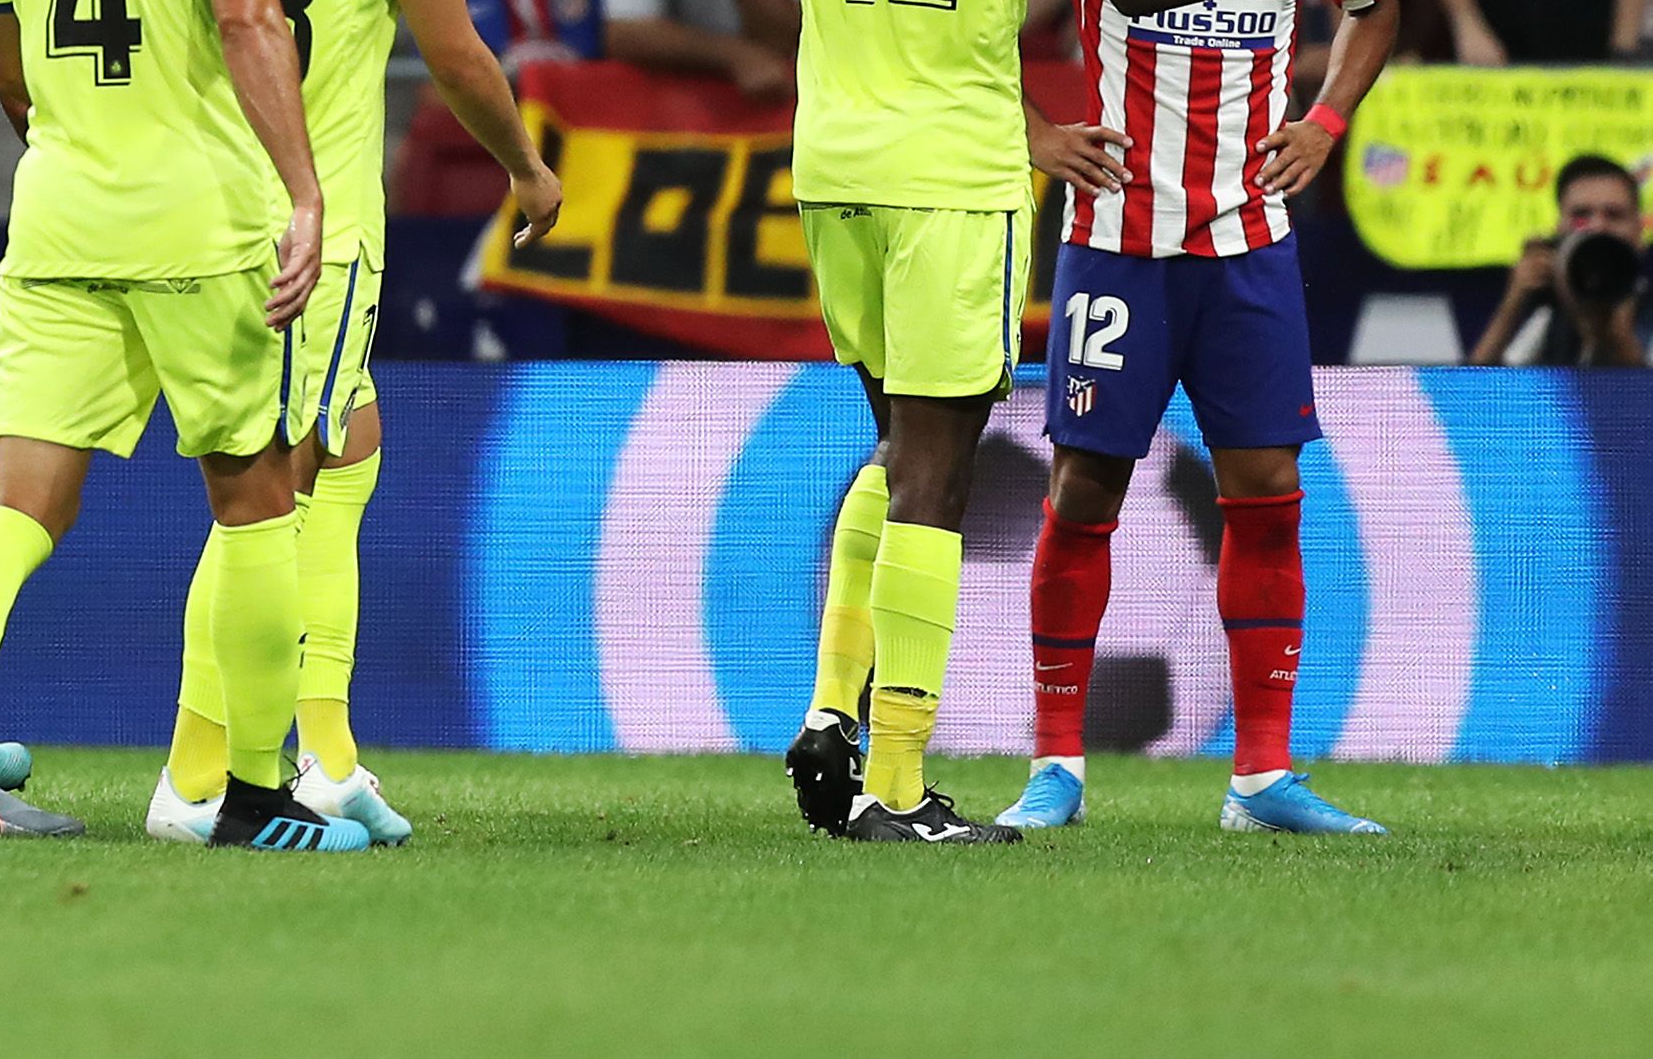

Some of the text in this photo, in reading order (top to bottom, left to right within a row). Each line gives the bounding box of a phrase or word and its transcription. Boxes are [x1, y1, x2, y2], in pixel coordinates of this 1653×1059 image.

[1131, 9, 1277, 34] lus500
[1173, 35, 1241, 49] Trade Online
[1065, 292, 1129, 371] 12
